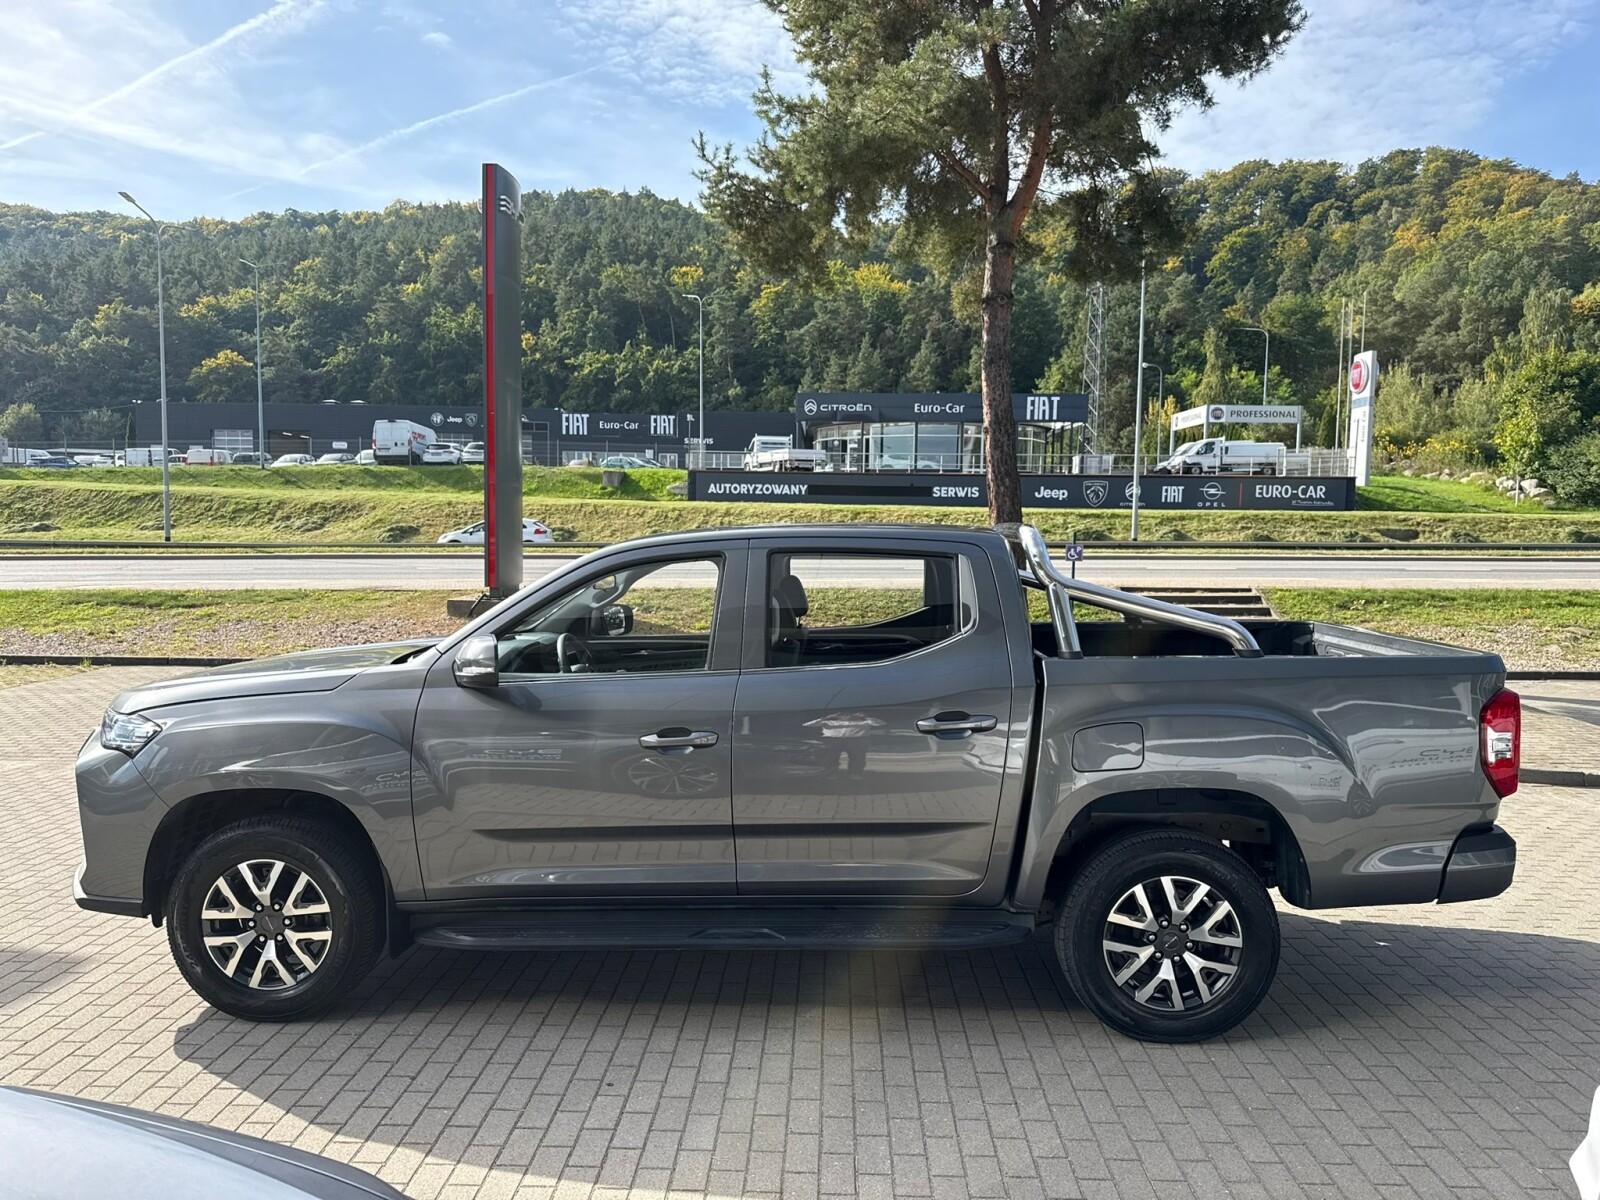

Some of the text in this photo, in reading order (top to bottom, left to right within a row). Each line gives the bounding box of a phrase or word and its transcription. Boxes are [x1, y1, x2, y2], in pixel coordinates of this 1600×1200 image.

[914, 402, 965, 414] Euro-Car
[1026, 396, 1061, 420] FIAT
[1230, 409, 1297, 419] PROFESSIONAL
[447, 413, 463, 423] Jeep
[562, 413, 590, 436] FIAT
[599, 420, 639, 430] Euro-Car
[650, 414, 676, 435] FIAT
[708, 482, 980, 498] AUTORYZOWANY SERWIS
[1034, 486, 1069, 500] Jeep
[1161, 485, 1185, 503] FIAT
[1255, 484, 1326, 499] EURO-CAR
